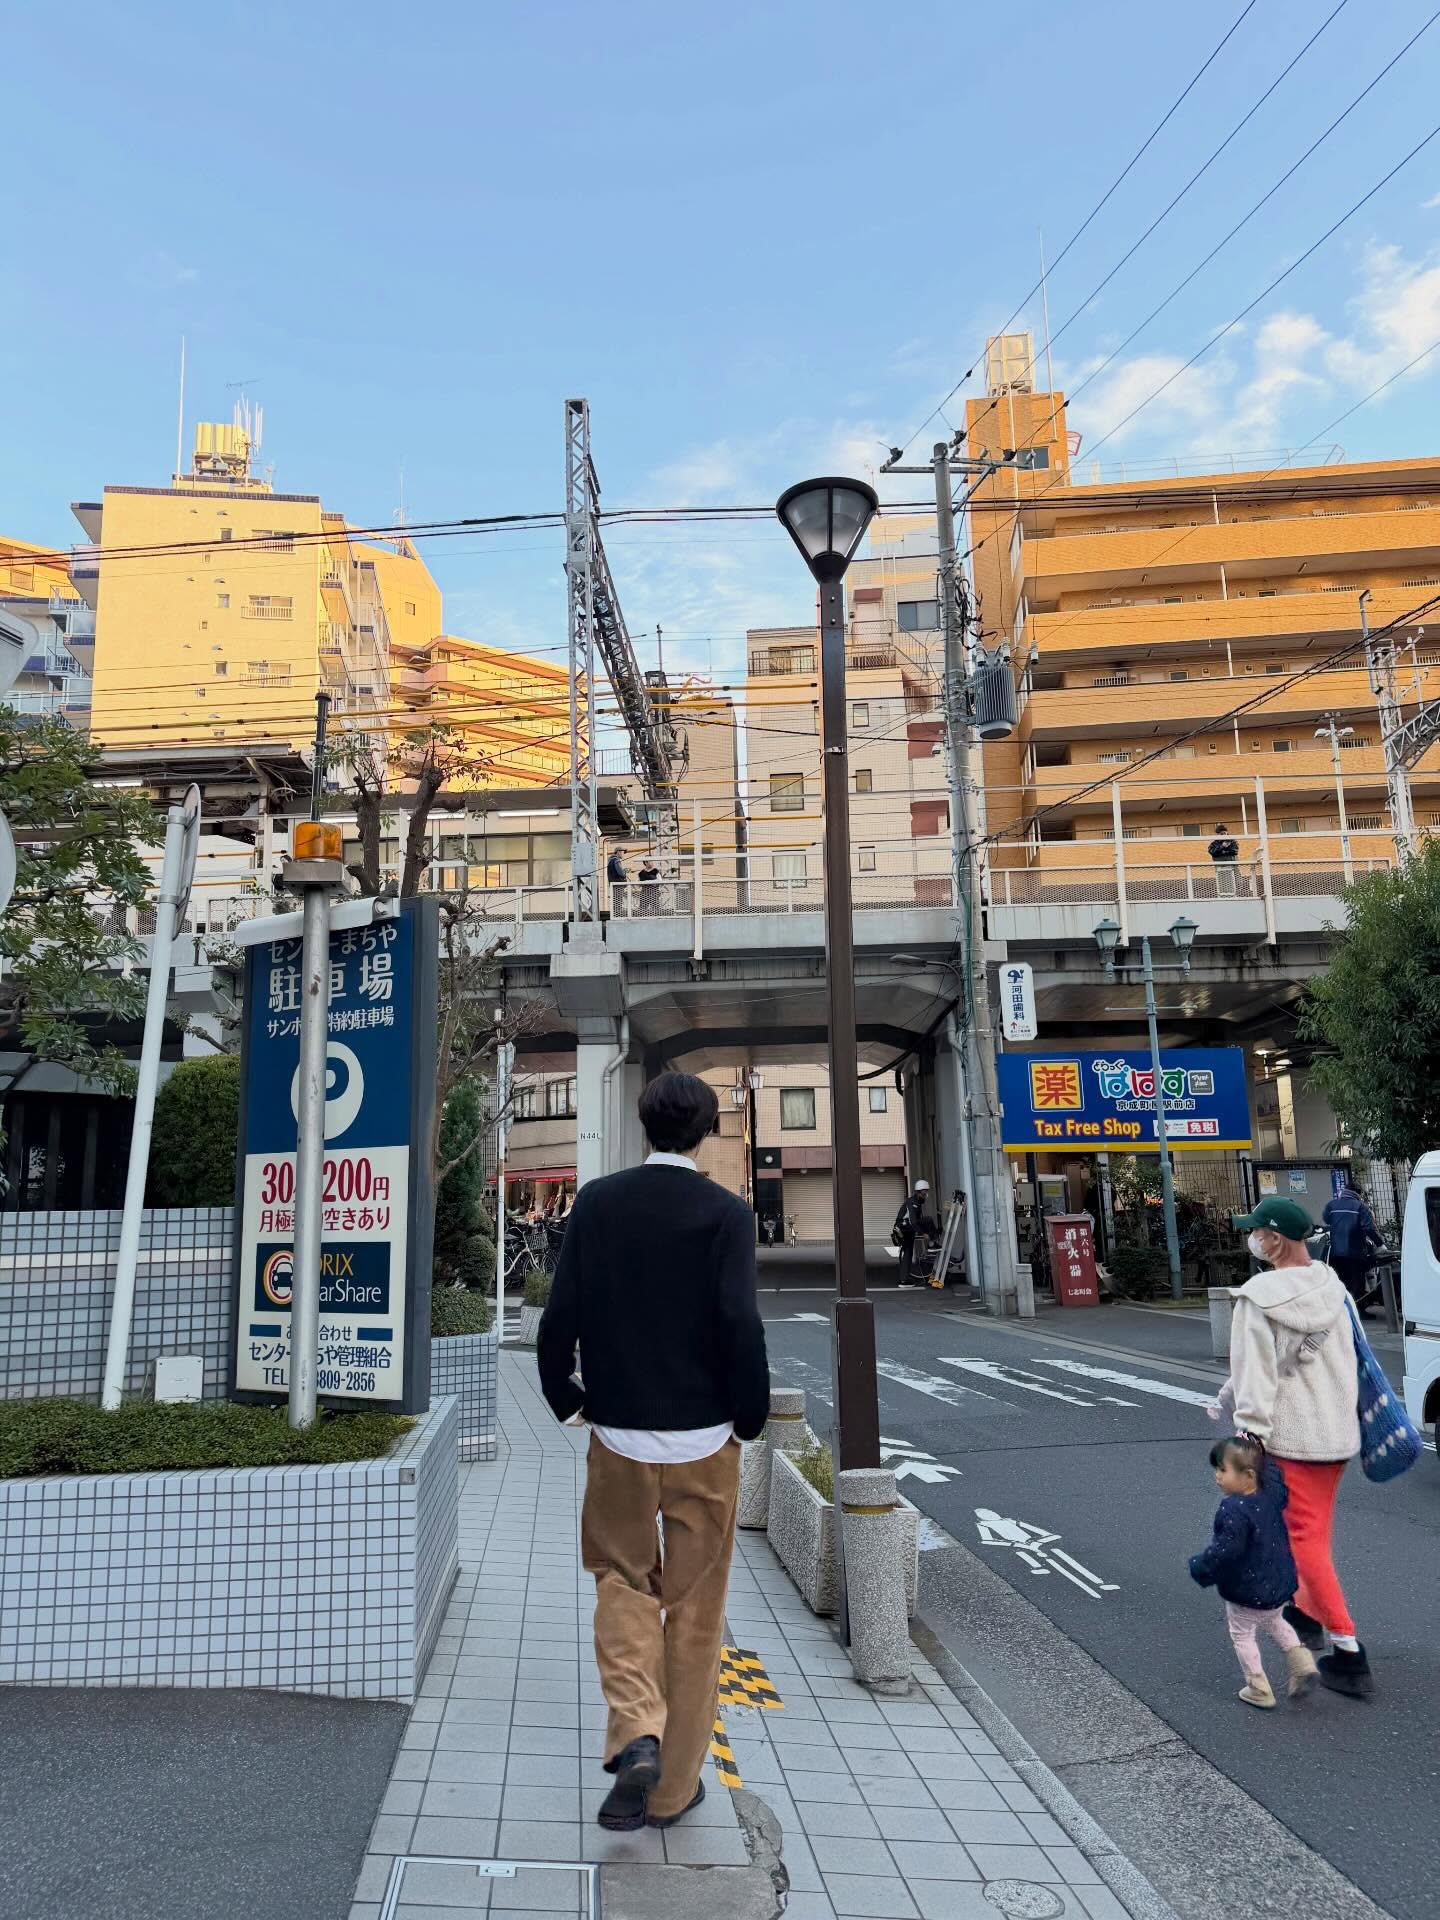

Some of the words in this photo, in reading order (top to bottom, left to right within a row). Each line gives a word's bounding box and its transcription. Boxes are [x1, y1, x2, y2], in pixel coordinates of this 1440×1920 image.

[267, 924, 398, 964] センーまちや
[1011, 985, 1025, 1021] 河田歯科
[266, 1005, 395, 1039] サン特約駐車場
[1034, 1065, 1078, 1106] 薬
[1034, 1120, 1062, 1137] Tax
[1066, 1119, 1100, 1136] Free
[1103, 1117, 1141, 1139] Shop
[1189, 1121, 1215, 1134] 免税
[261, 1157, 390, 1205] 30200円
[258, 1206, 391, 1233] 月極空きあり
[320, 1253, 354, 1277] RIX
[319, 1278, 382, 1303] arShare
[286, 1324, 353, 1343] 合わせ
[248, 1341, 392, 1369] センタや管理組合
[262, 1367, 289, 1386] TEL
